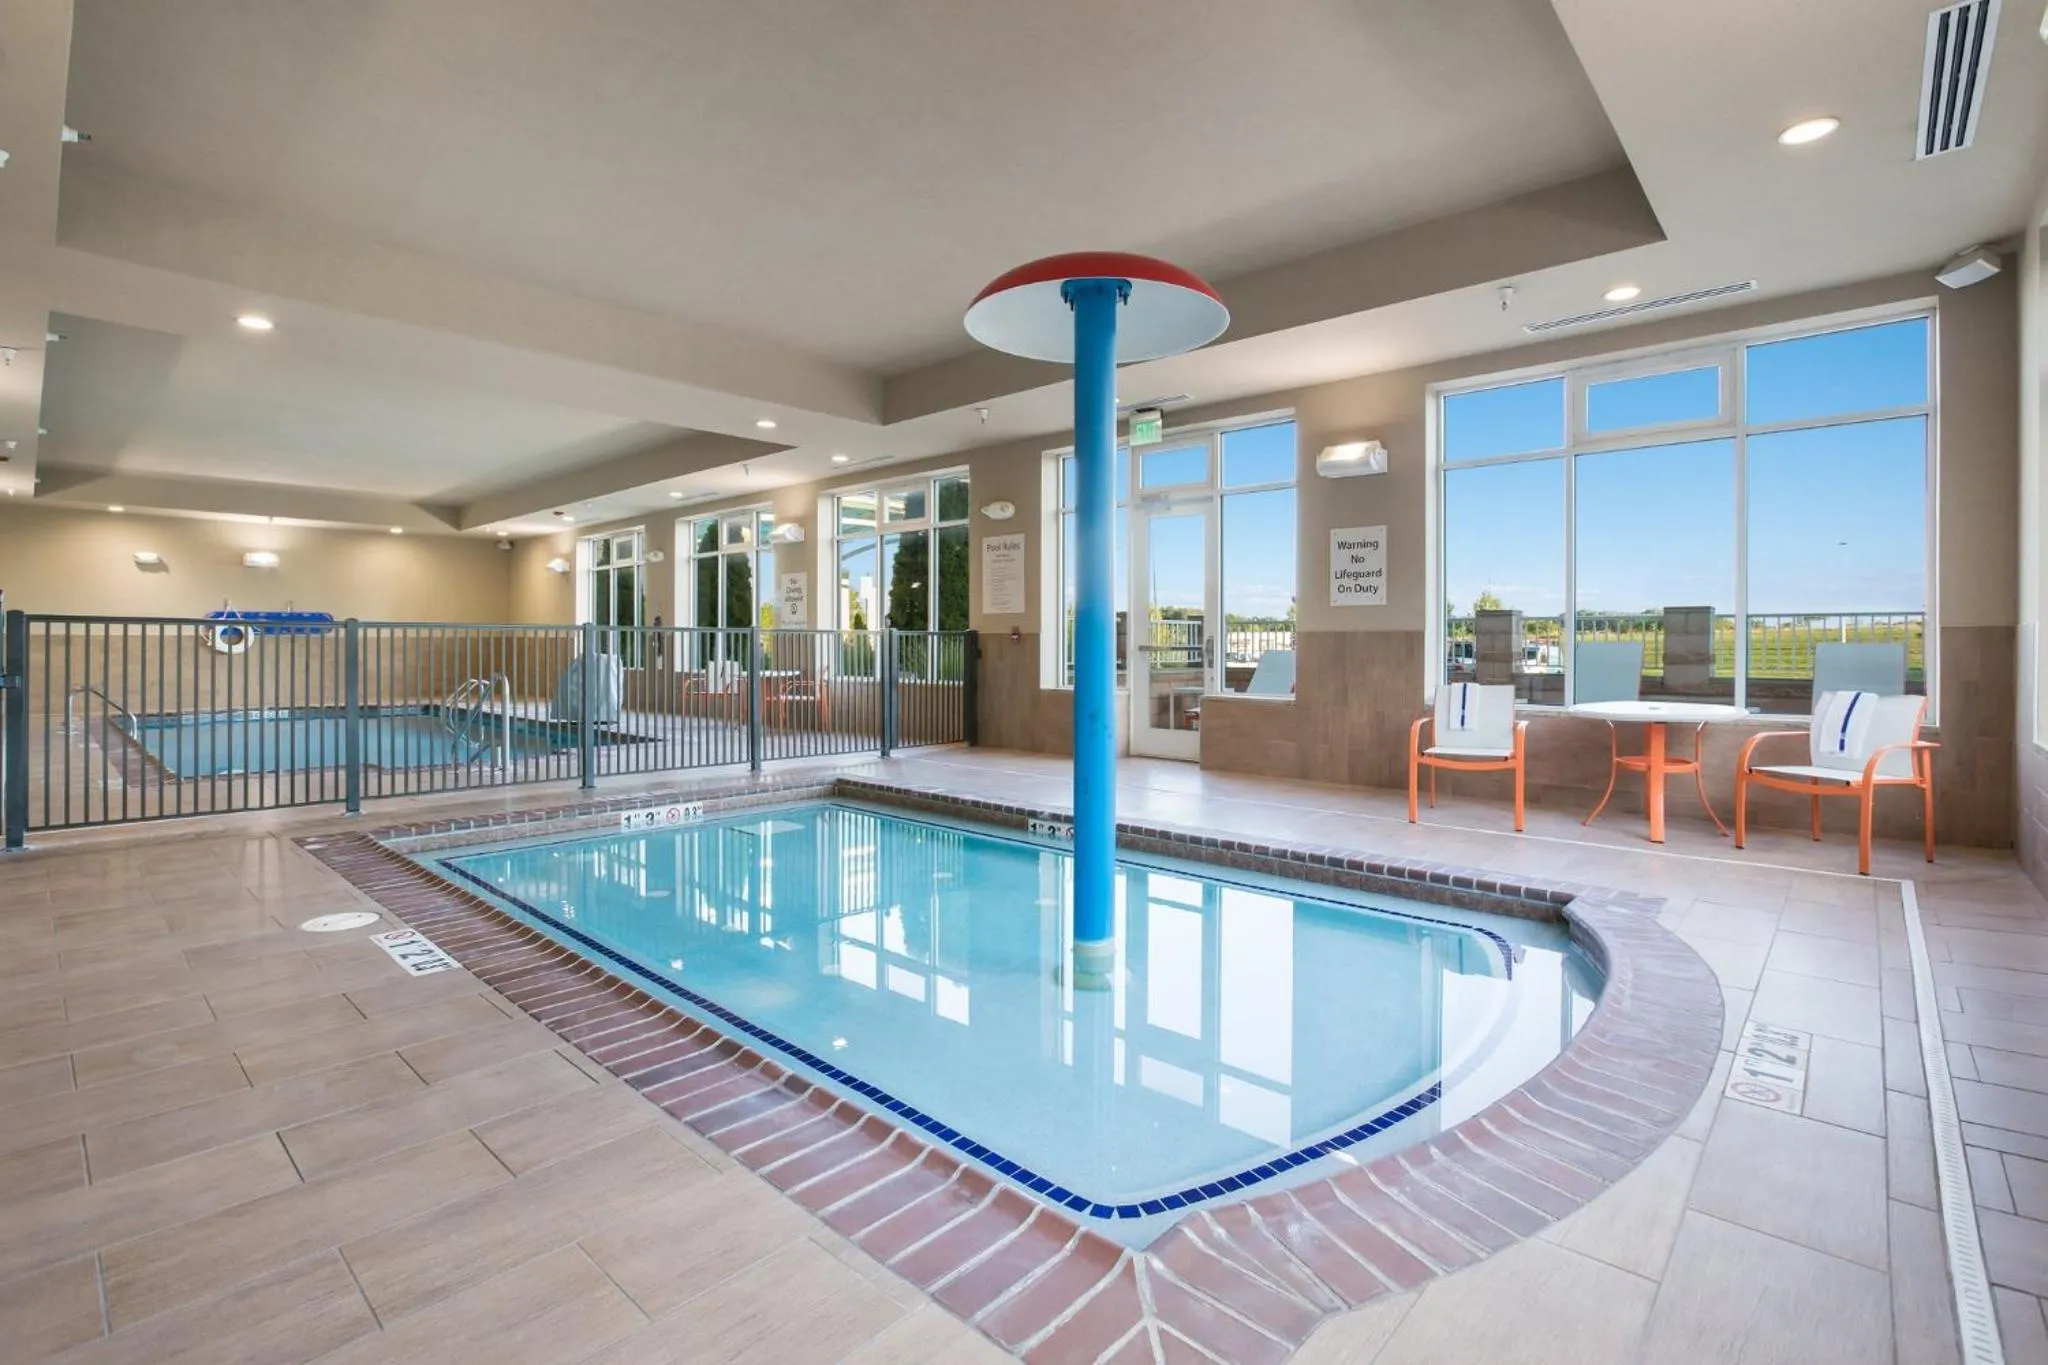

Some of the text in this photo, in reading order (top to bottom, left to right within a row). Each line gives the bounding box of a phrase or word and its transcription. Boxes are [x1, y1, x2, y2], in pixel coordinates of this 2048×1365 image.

[986, 541, 1001, 552] Pool
[1337, 540, 1379, 550] Warning
[1351, 554, 1365, 564] No
[1335, 568, 1382, 580] Lifeguard
[1338, 584, 1379, 595] On Duty
